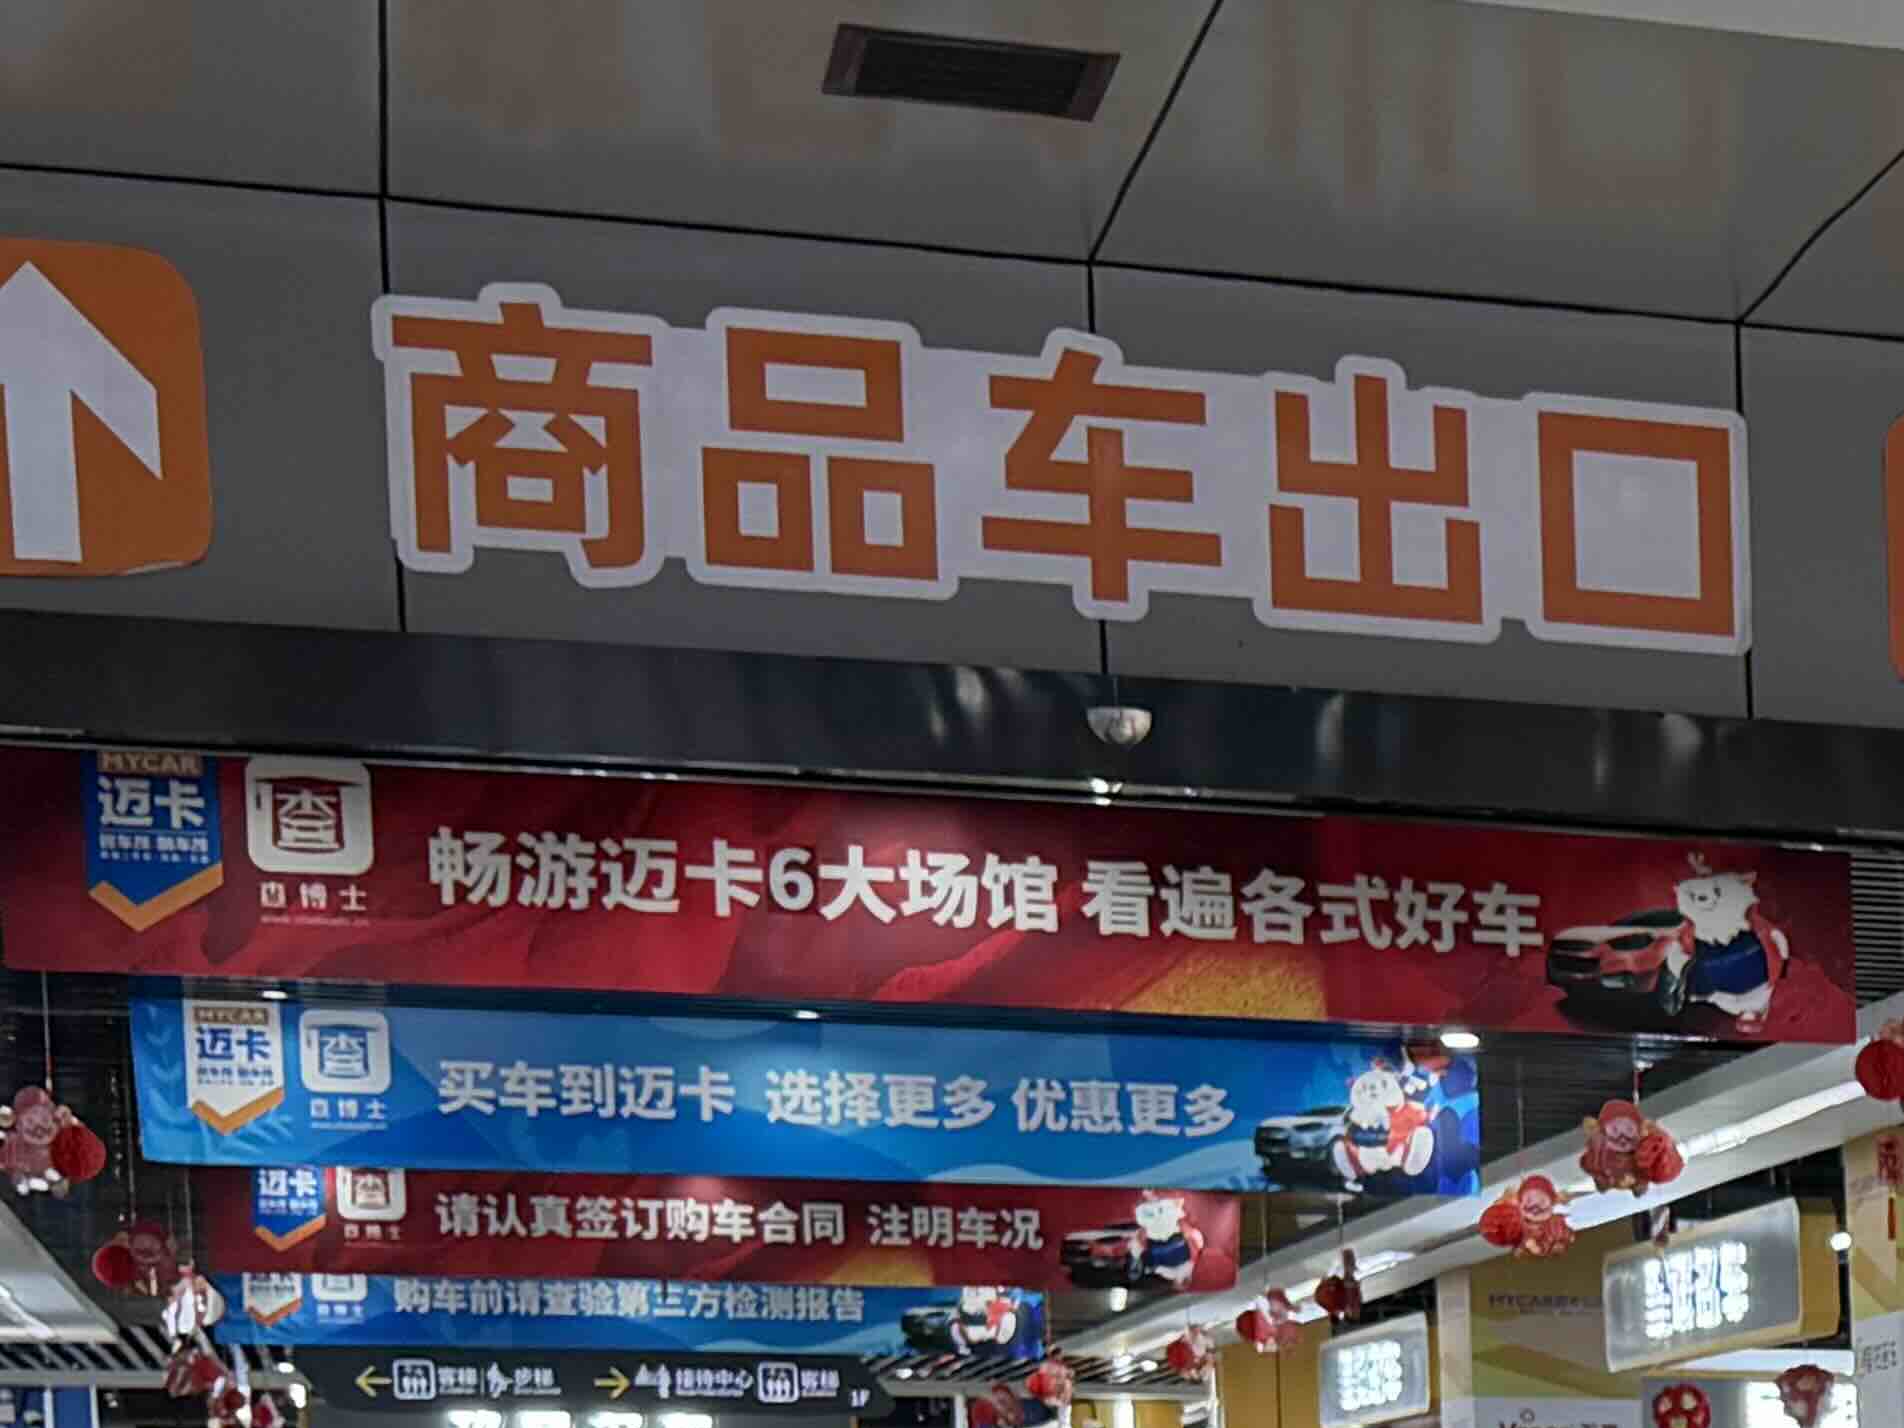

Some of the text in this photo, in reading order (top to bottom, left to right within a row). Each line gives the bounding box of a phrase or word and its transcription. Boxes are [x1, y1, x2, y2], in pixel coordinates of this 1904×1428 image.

[384, 294, 1745, 646] 商品车出口
[97, 775, 205, 830] 迈卡
[427, 825, 1544, 957] 畅游迈卡6大场馆 看遍各式好车
[196, 1027, 271, 1062] 迈卡
[437, 1059, 1237, 1137] 买车到迈卡 选择更多 优惠更多
[257, 1168, 318, 1197] 迈卡
[434, 1190, 1044, 1252] 请认真签订购车合同 注明车况
[393, 1278, 865, 1322] 购车前请查验第三方检测报告
